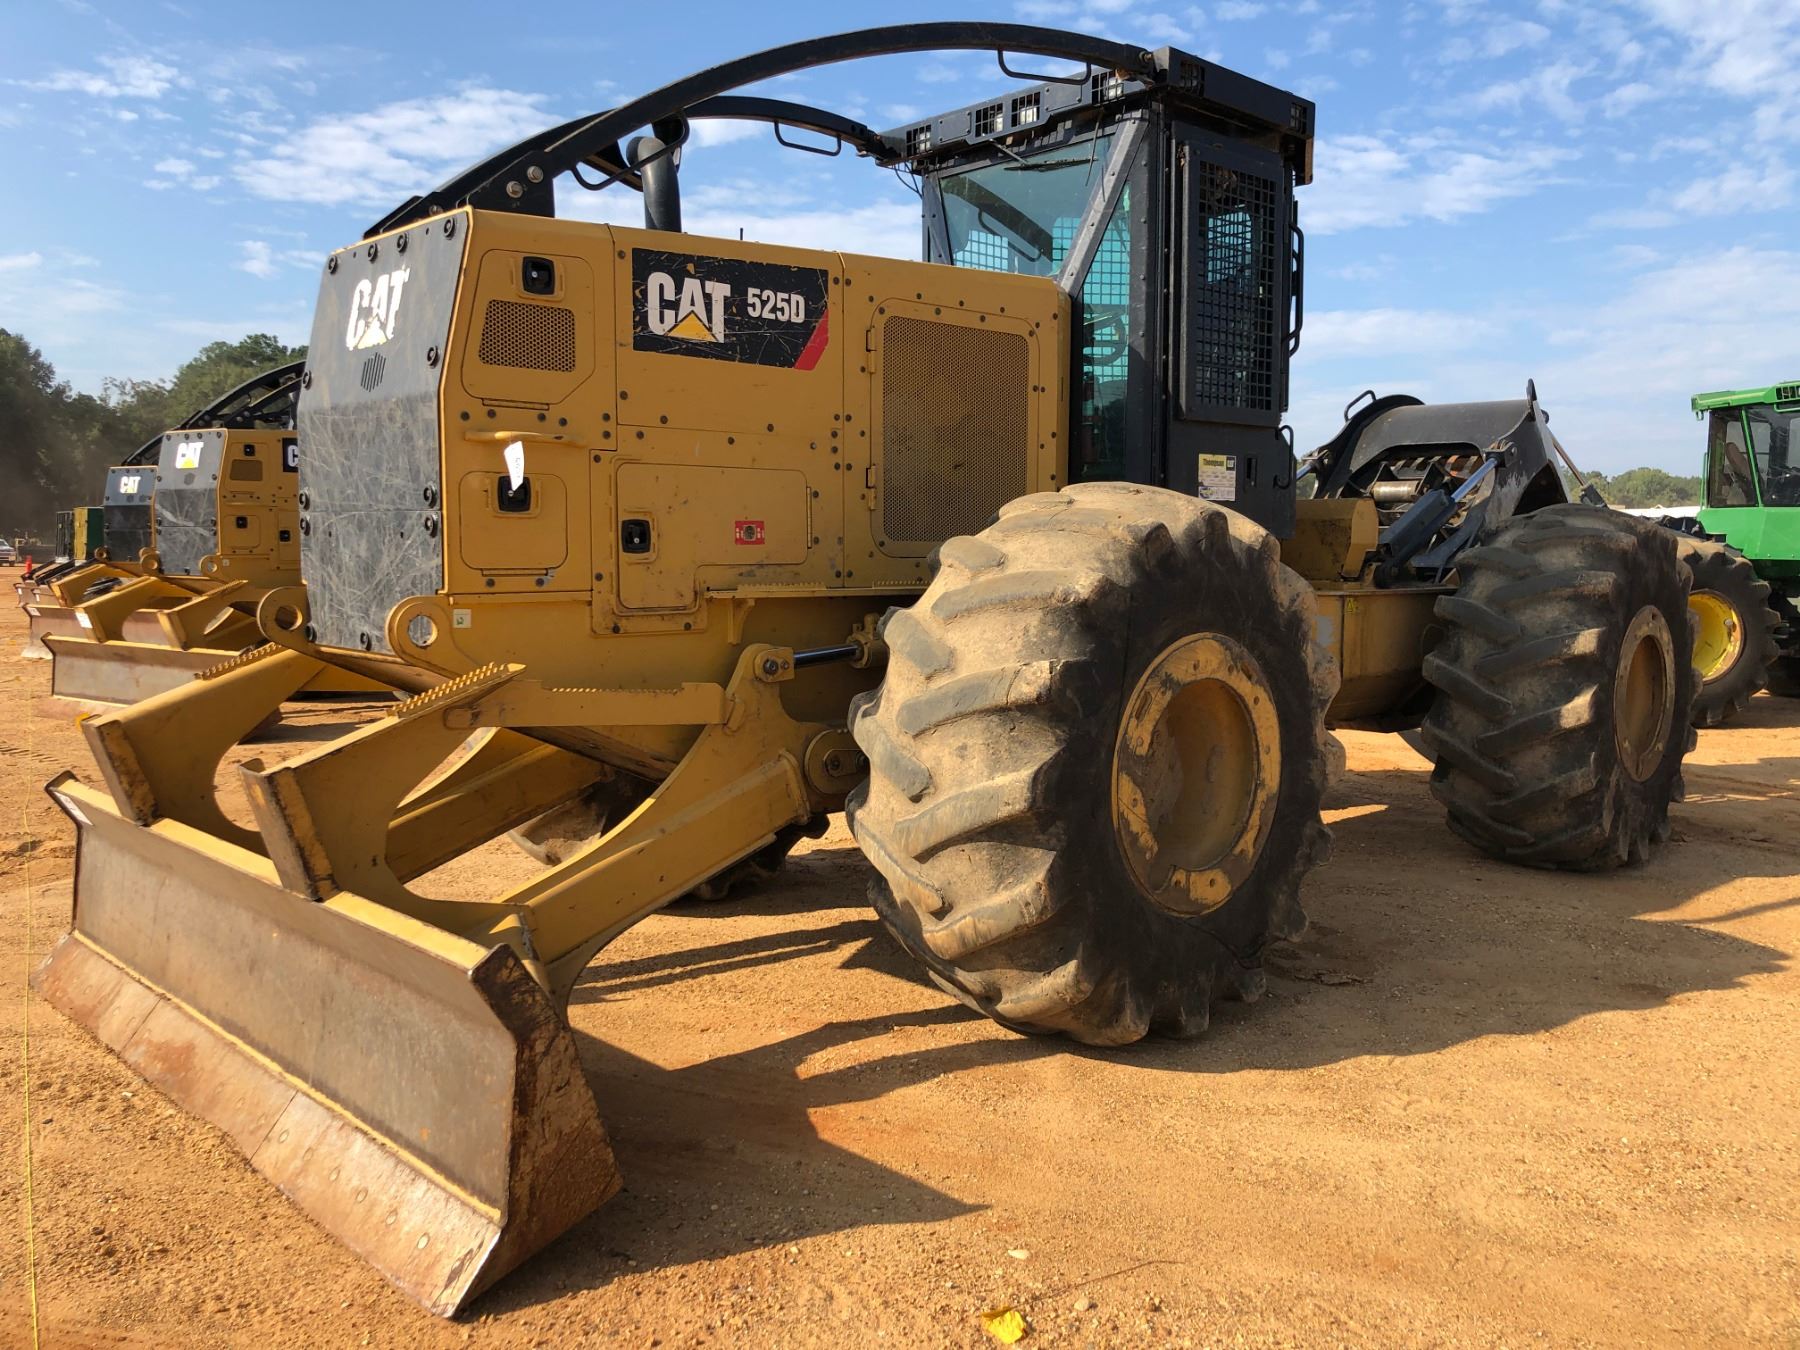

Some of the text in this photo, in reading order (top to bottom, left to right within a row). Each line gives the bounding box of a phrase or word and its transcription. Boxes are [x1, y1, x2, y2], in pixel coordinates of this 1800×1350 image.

[346, 267, 410, 351] CAT
[647, 271, 806, 344] CAT 525D
[175, 441, 204, 469] CAT
[120, 475, 141, 494] CAT
